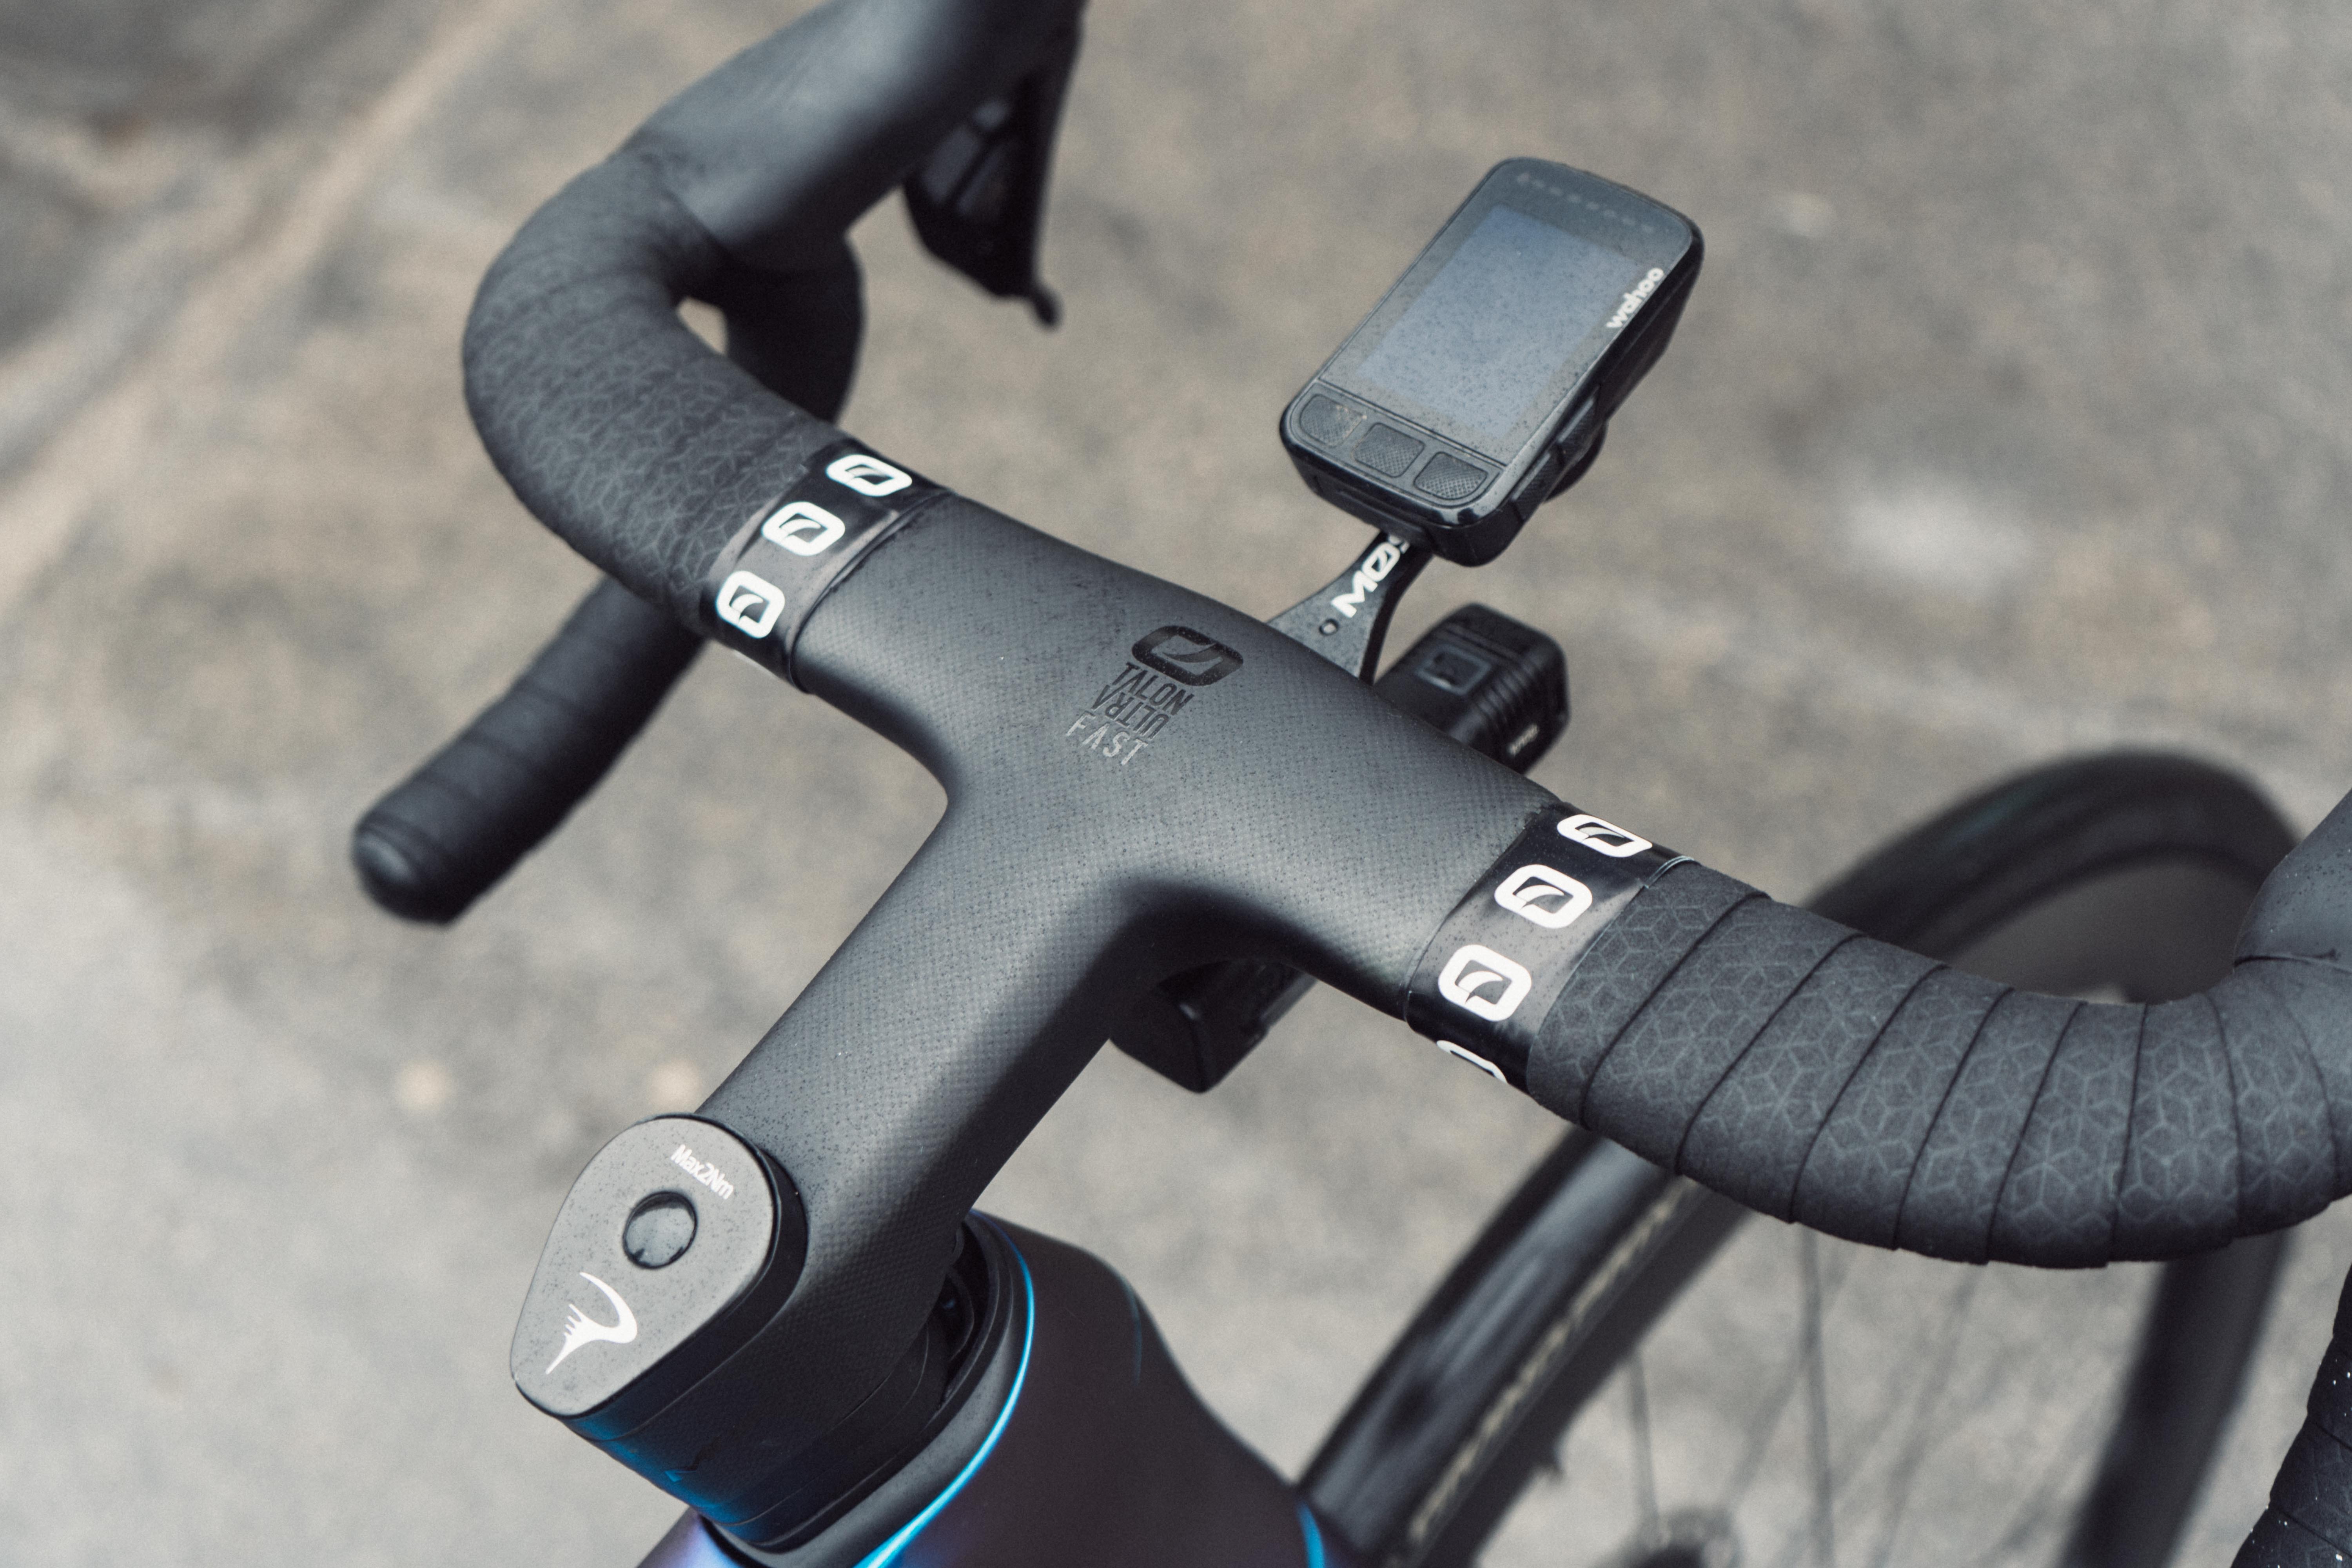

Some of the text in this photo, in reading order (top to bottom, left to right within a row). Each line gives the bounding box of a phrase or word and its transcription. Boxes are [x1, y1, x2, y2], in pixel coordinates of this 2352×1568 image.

[1606, 267, 1664, 328] wahoo
[1091, 684, 1169, 740] ULTRA
[1112, 662, 1195, 715] TALON
[1065, 710, 1149, 766] FAST
